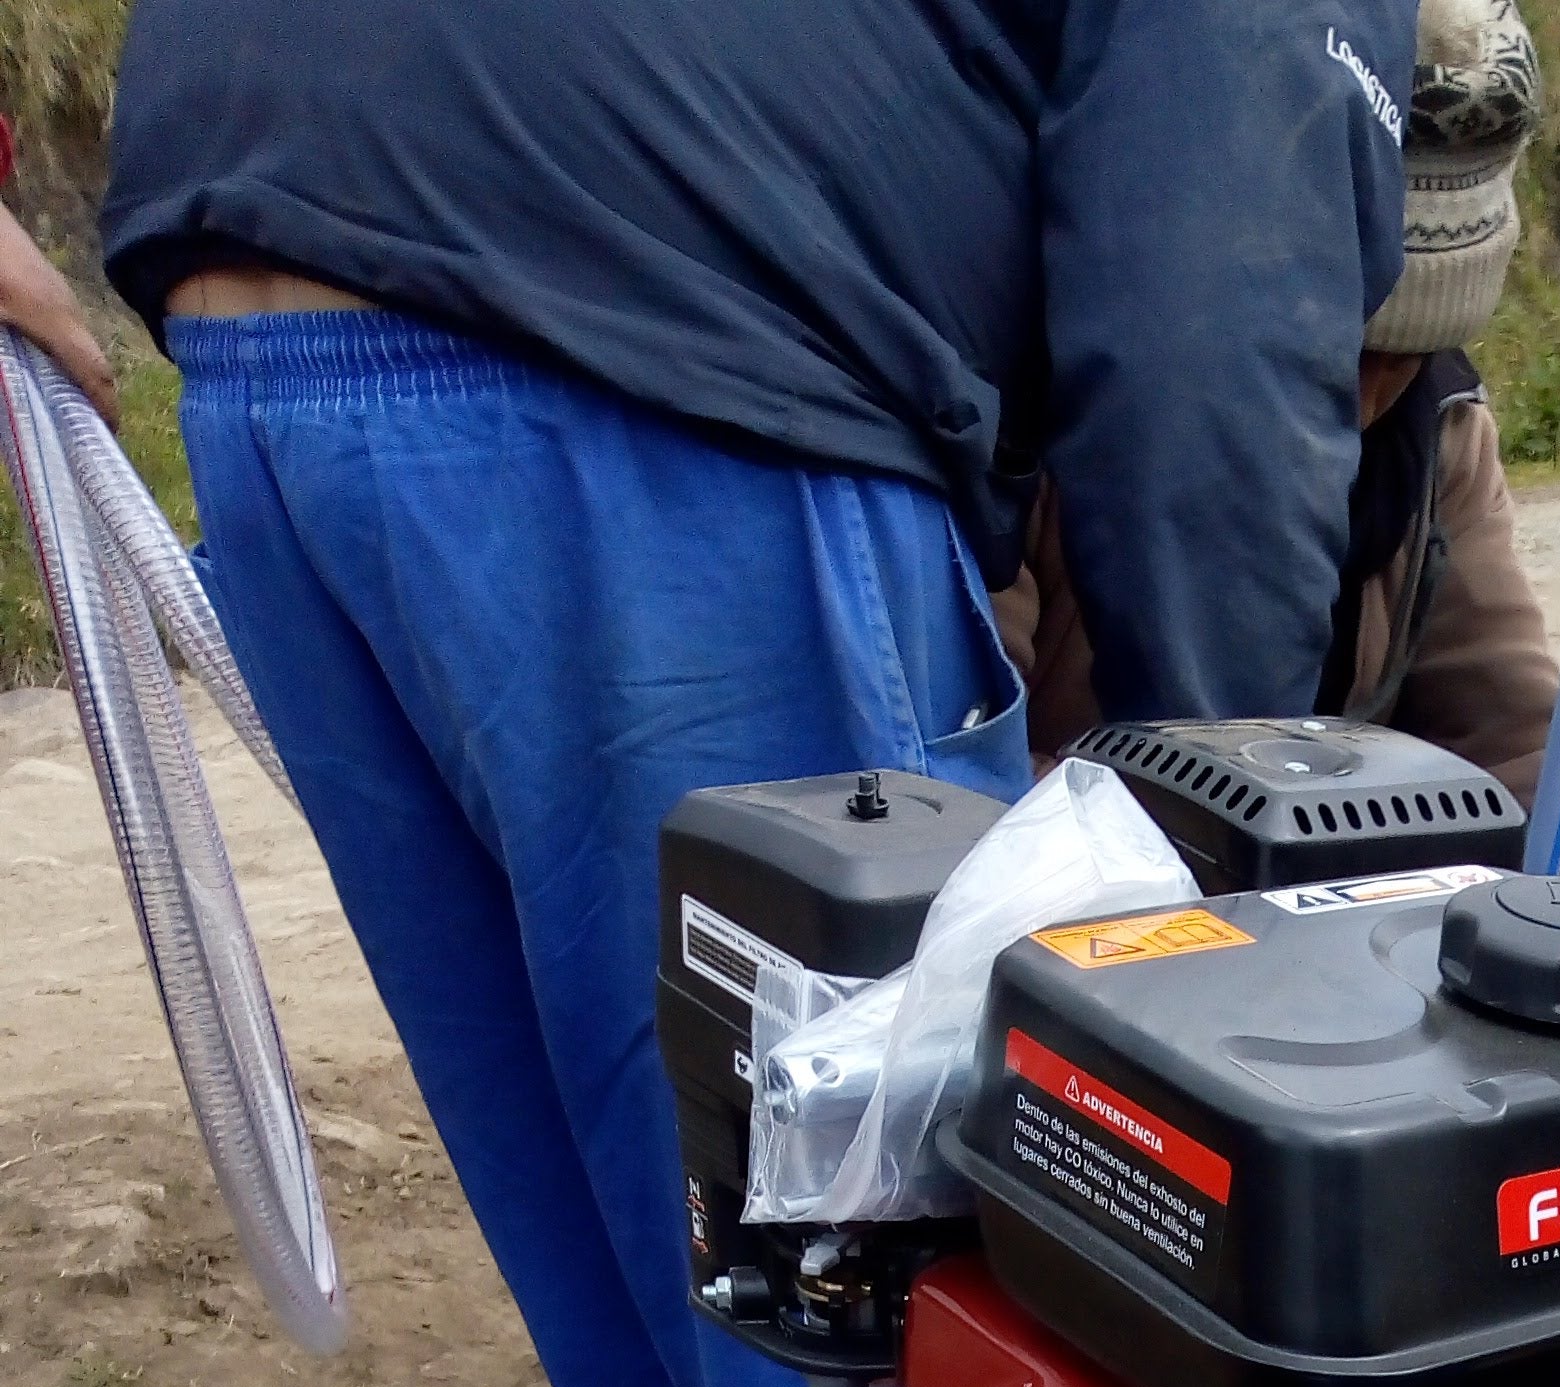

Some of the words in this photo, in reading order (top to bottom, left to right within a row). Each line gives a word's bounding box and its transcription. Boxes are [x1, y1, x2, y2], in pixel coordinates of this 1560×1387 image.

[1015, 1118, 1044, 1144] motor
[1044, 1133, 1062, 1160] hay
[1064, 1149, 1082, 1169] CO
[1117, 1179, 1149, 1214] Nunca
[1150, 1201, 1159, 1221] lo
[1161, 1210, 1189, 1242] utilice
[1190, 1232, 1204, 1252] en
[1016, 1093, 1049, 1126] Dentro
[1050, 1115, 1064, 1135] de
[1066, 1123, 1080, 1146] las
[1082, 1137, 1131, 1178] emisiones
[1132, 1168, 1149, 1190] del
[1149, 1177, 1188, 1217] exhosto
[1189, 1206, 1206, 1229] del
[1082, 1091, 1164, 1154] ADVERTENCIA
[1013, 1136, 1049, 1171] lugares
[1050, 1163, 1092, 1200] cerrados
[1094, 1189, 1108, 1211] sin
[1110, 1198, 1141, 1232] buena
[1143, 1224, 1196, 1271] ventilación.
